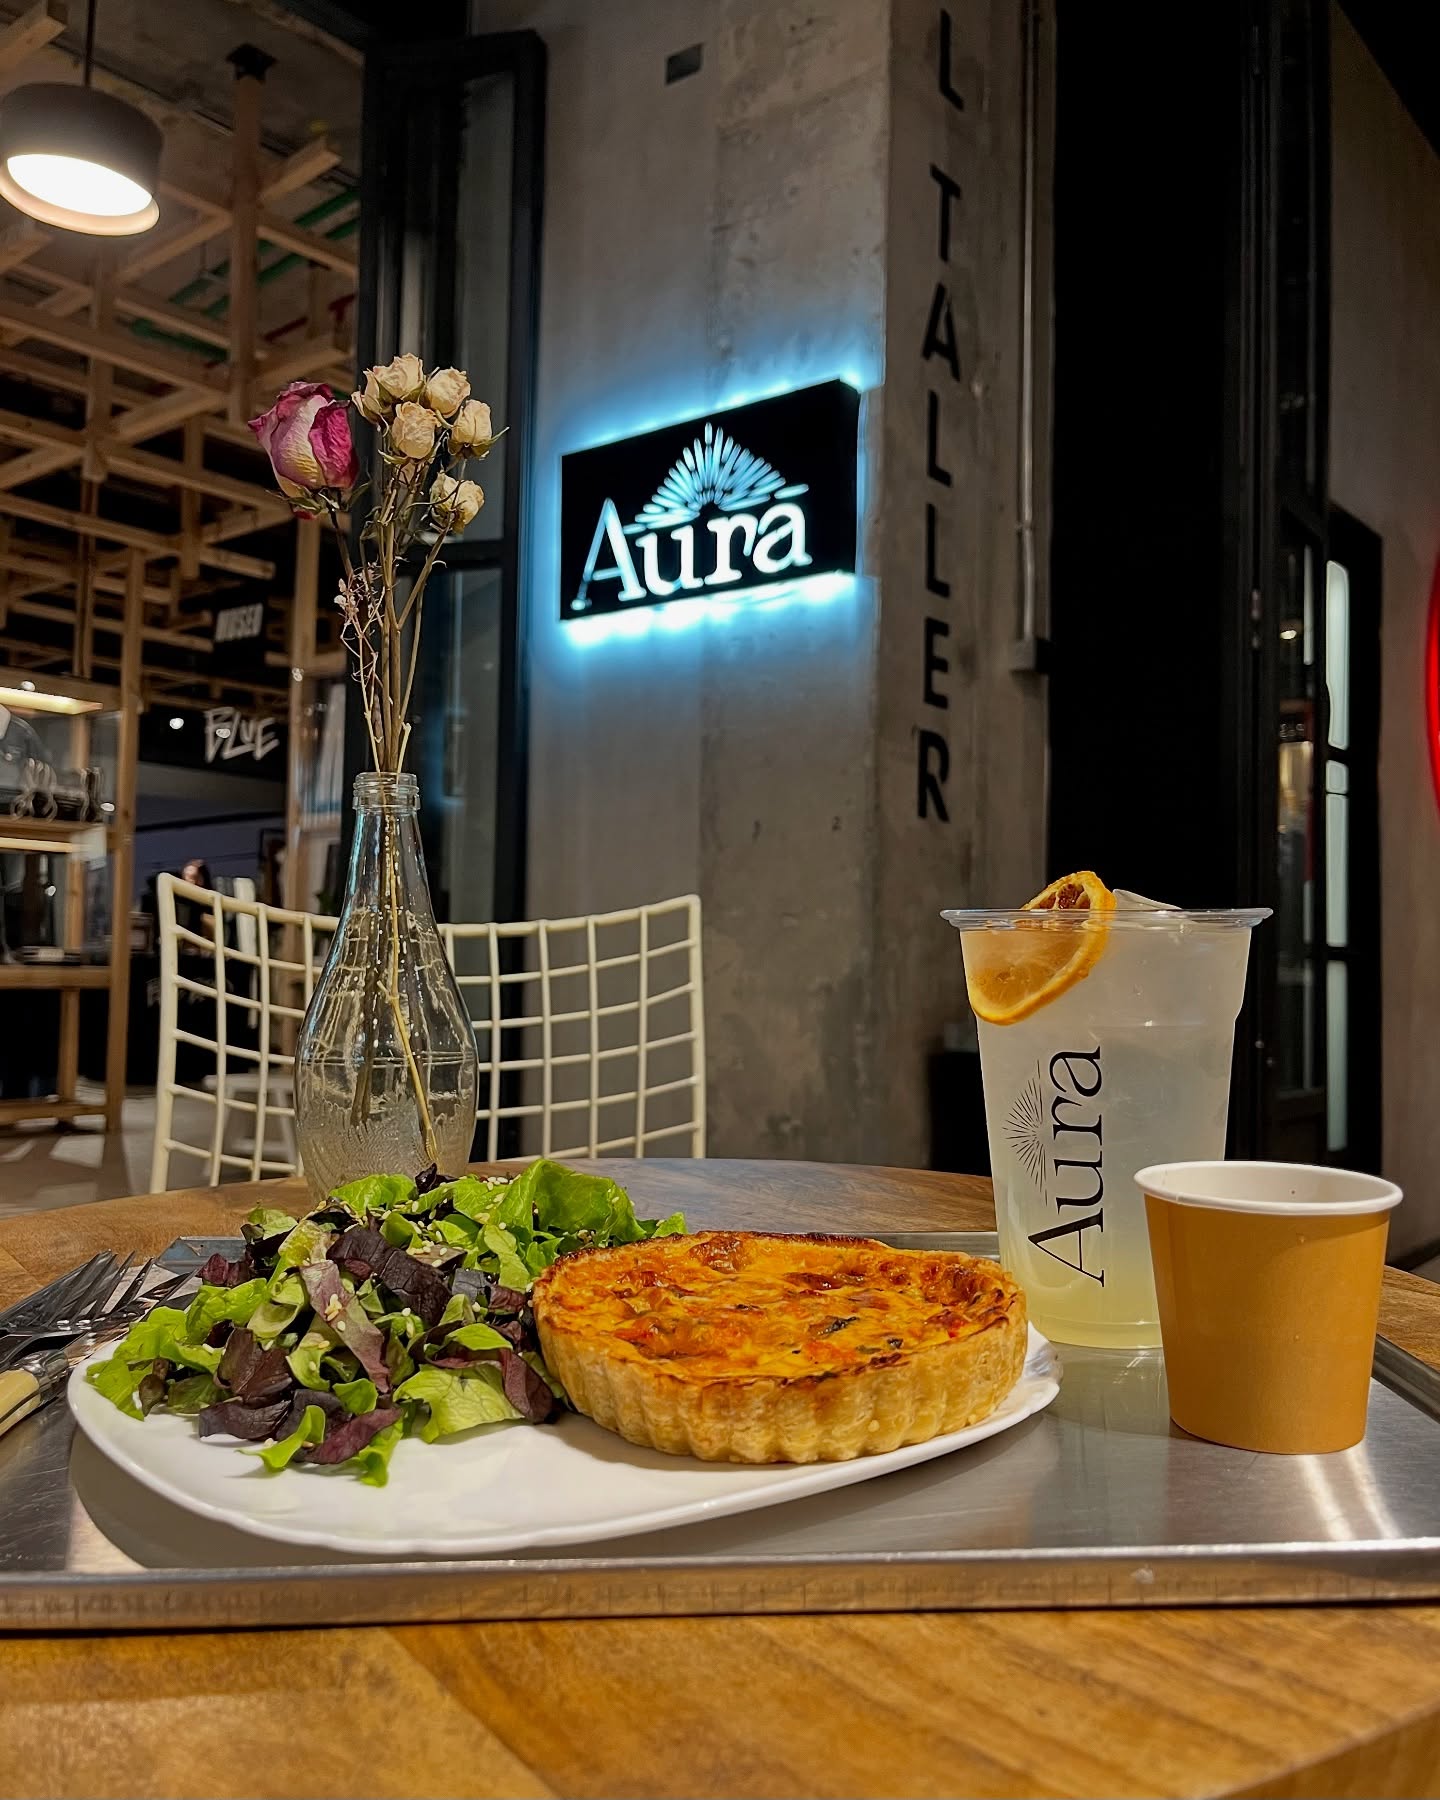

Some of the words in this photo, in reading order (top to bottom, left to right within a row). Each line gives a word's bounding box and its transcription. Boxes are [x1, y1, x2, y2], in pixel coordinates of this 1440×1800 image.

[570, 497, 812, 611] Aura
[917, 163, 961, 824] TALLER
[204, 705, 279, 763] BLUE
[1027, 1046, 1105, 1287] Aura
